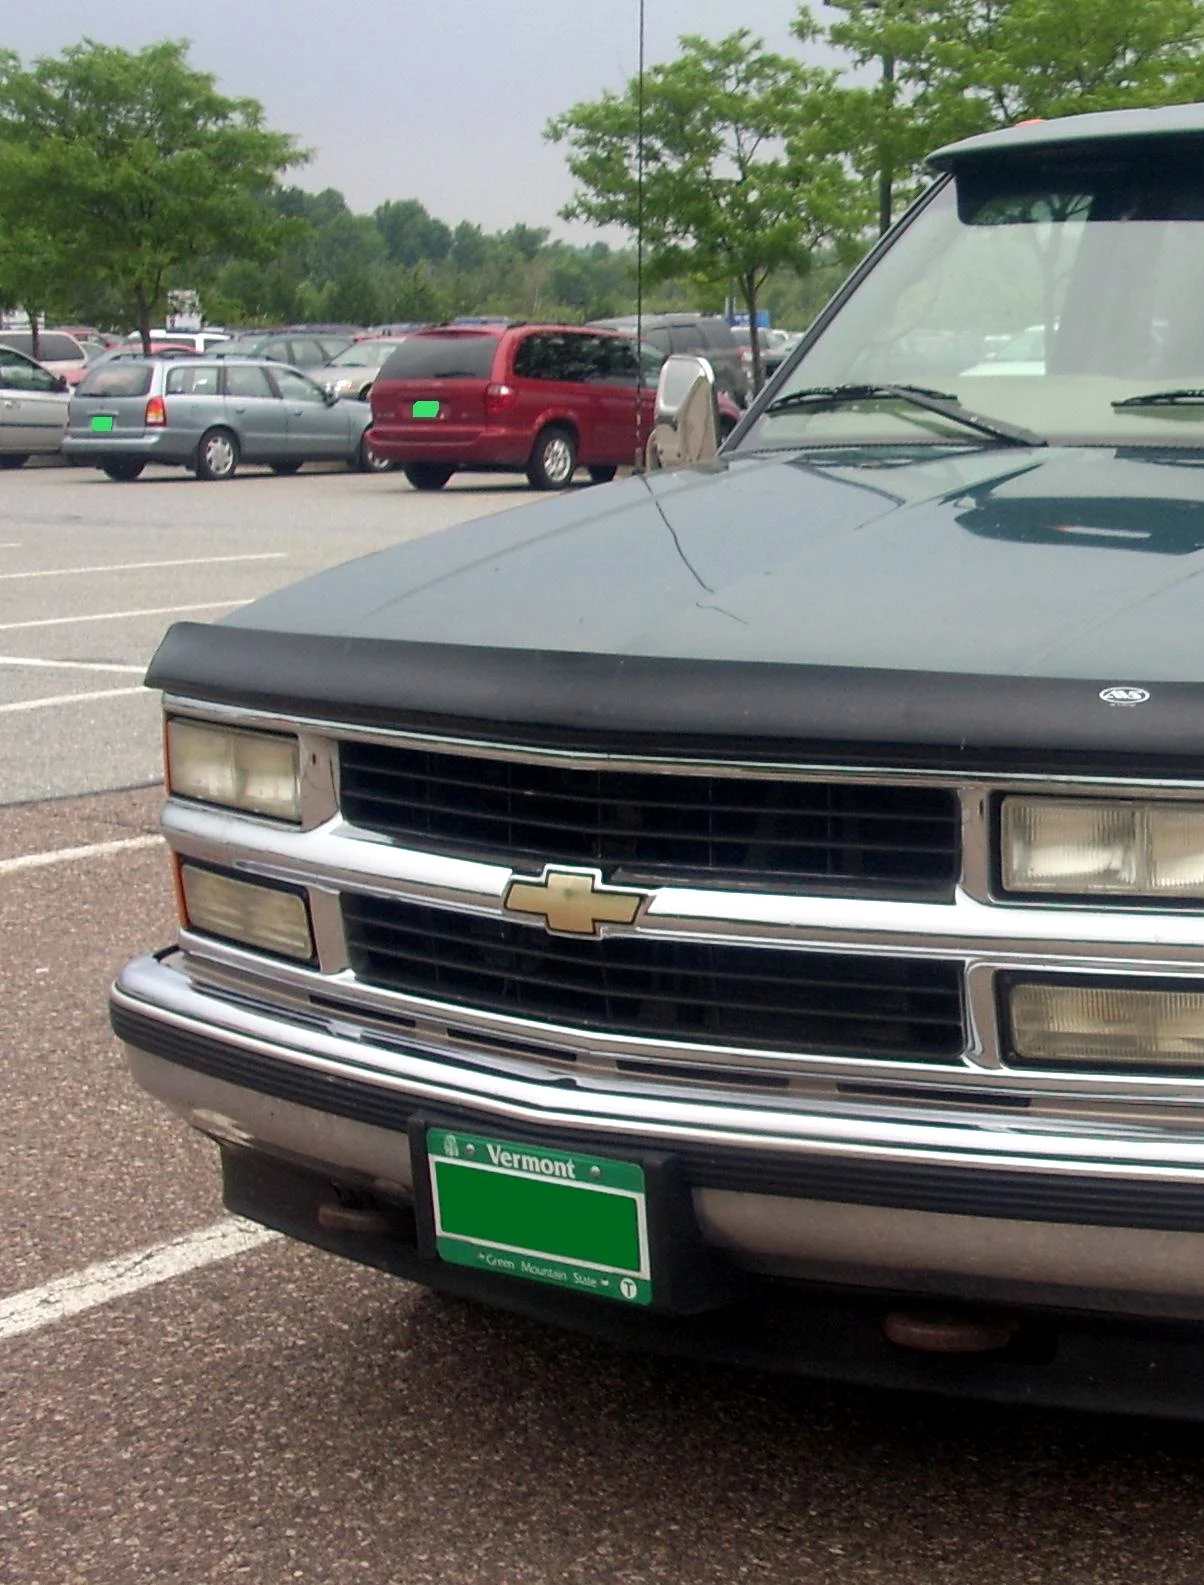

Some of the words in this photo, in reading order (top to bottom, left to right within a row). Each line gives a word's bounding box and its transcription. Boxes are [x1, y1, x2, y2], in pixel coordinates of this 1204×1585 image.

[487, 1144, 576, 1179] Vermont
[486, 1254, 515, 1269] Green
[521, 1262, 567, 1281] Mountain
[573, 1272, 598, 1288] State
[622, 1281, 635, 1298] T
